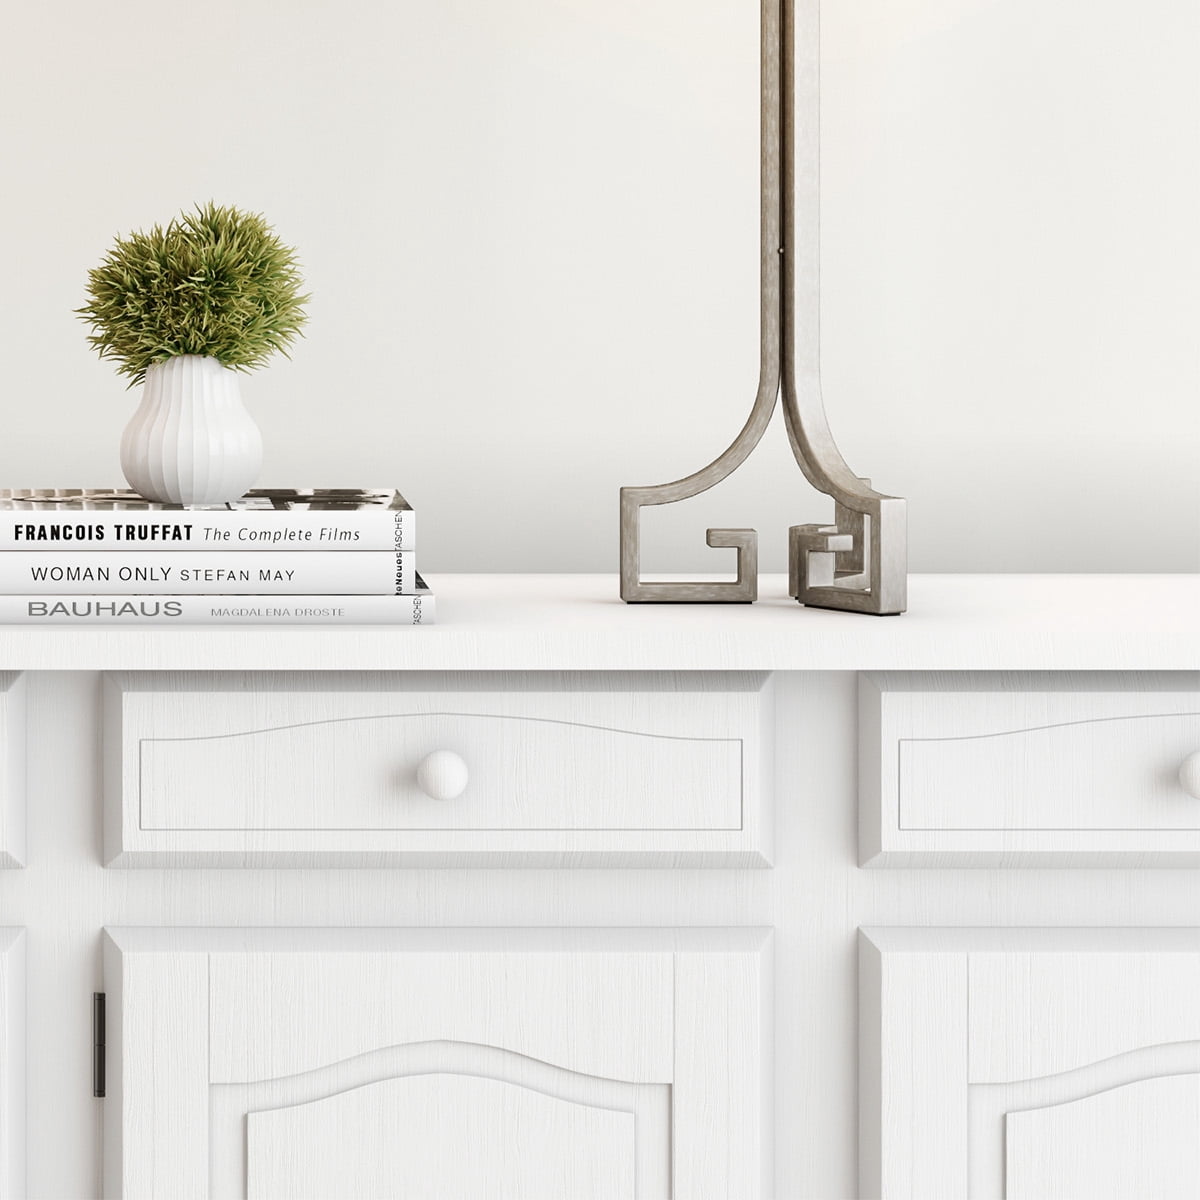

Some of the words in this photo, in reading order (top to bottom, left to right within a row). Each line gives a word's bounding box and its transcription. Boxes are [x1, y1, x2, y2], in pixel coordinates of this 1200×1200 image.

[14, 524, 105, 541] FRANCOIS
[114, 524, 193, 541] TRUFFAT
[203, 527, 231, 541] The
[238, 527, 313, 543] Complete
[319, 527, 361, 541] Films
[31, 566, 110, 582] WOMAN
[118, 566, 172, 582] ONLY
[180, 569, 250, 582] STEFAN
[259, 569, 295, 582] MAY
[27, 601, 183, 617] BAUHAUS
[210, 607, 291, 617] MAGDALENA
[295, 607, 346, 617] DROSTE
